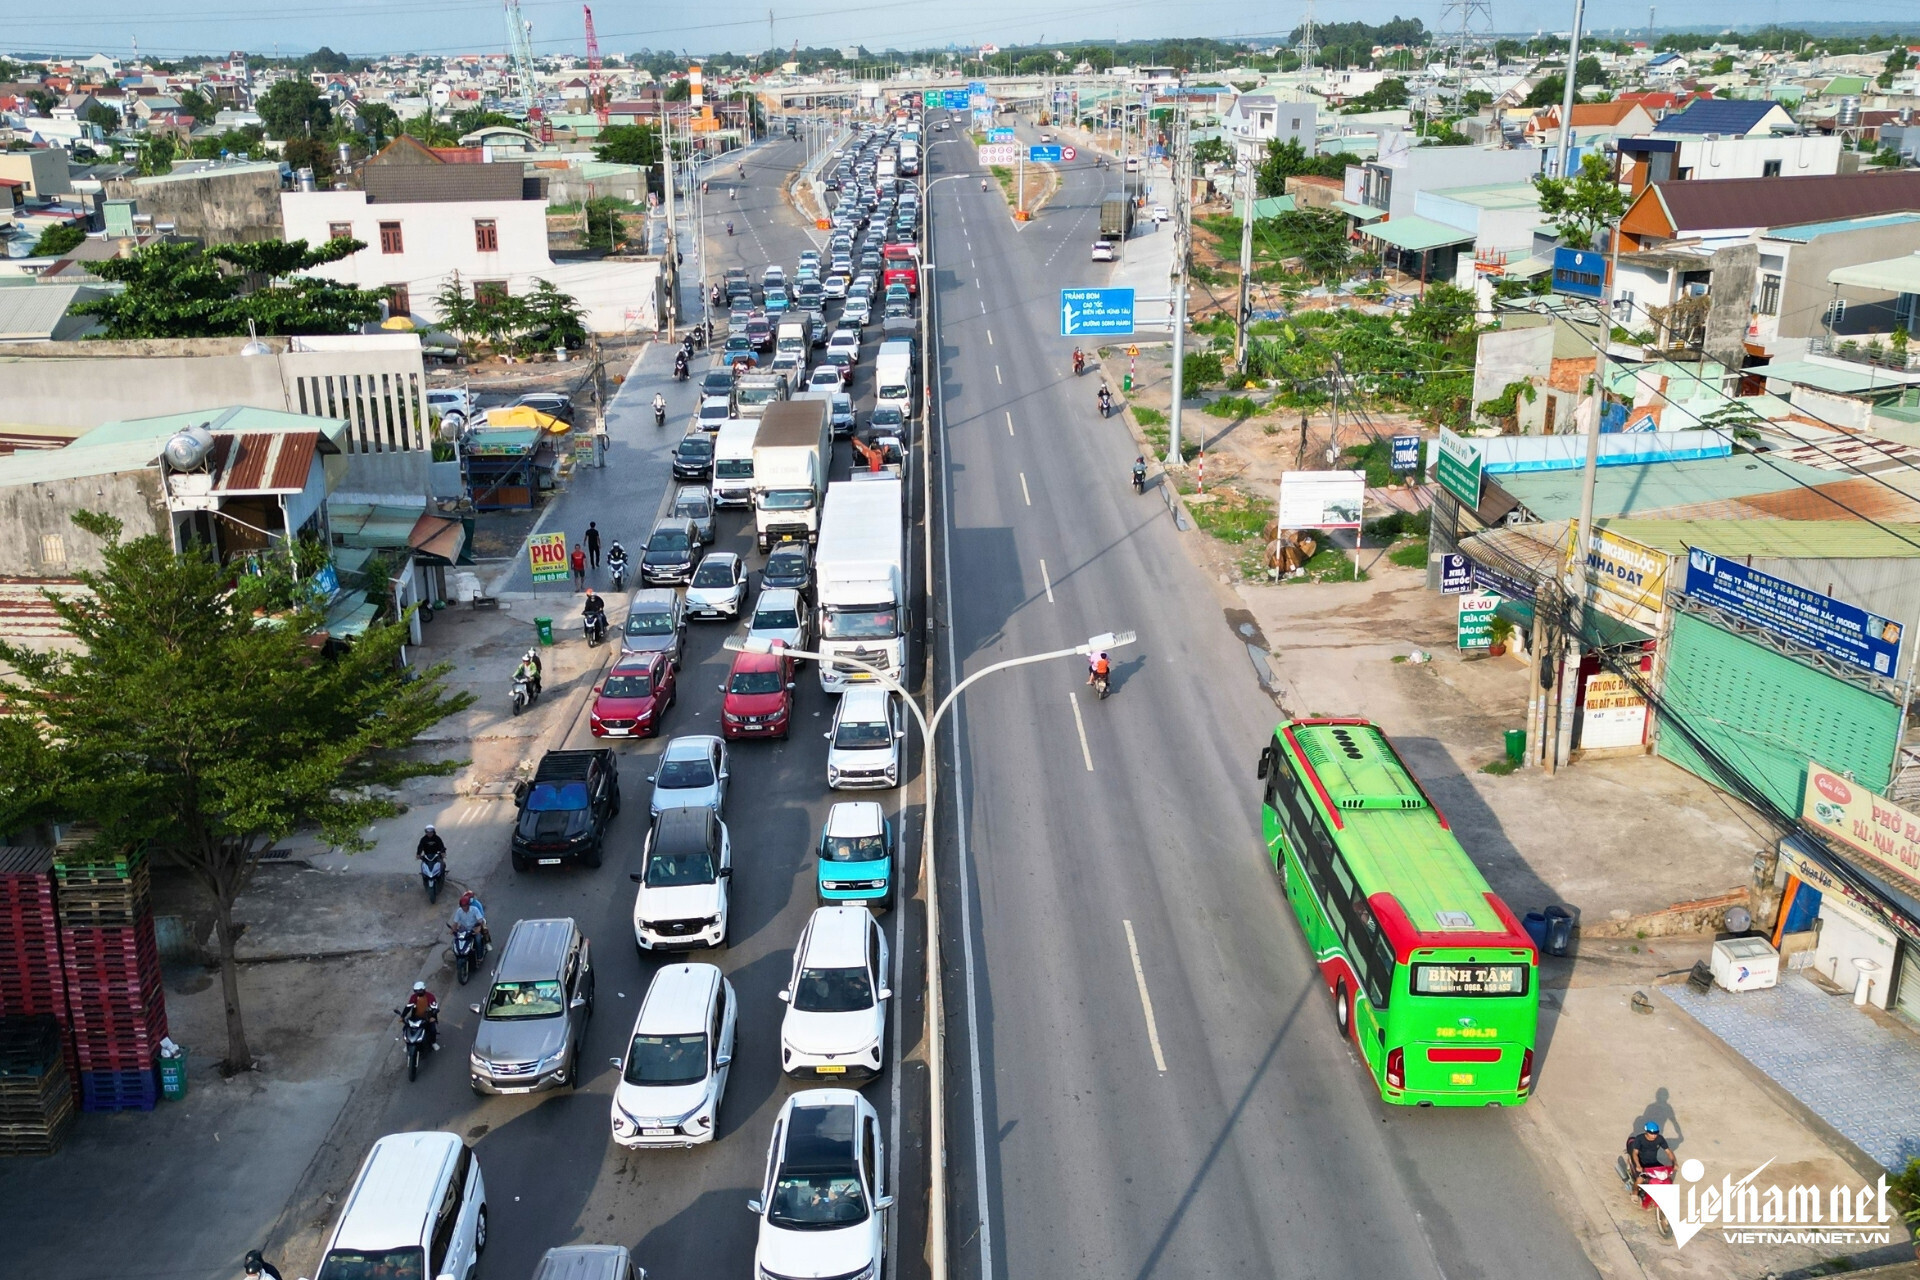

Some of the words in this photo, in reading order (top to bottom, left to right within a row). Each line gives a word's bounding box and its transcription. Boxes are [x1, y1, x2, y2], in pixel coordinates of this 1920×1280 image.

[531, 536, 565, 563] PHỞ
[1871, 805, 1902, 833] PHỞ
[1428, 967, 1471, 982] BÌNH
[1476, 968, 1513, 982] TÂM
